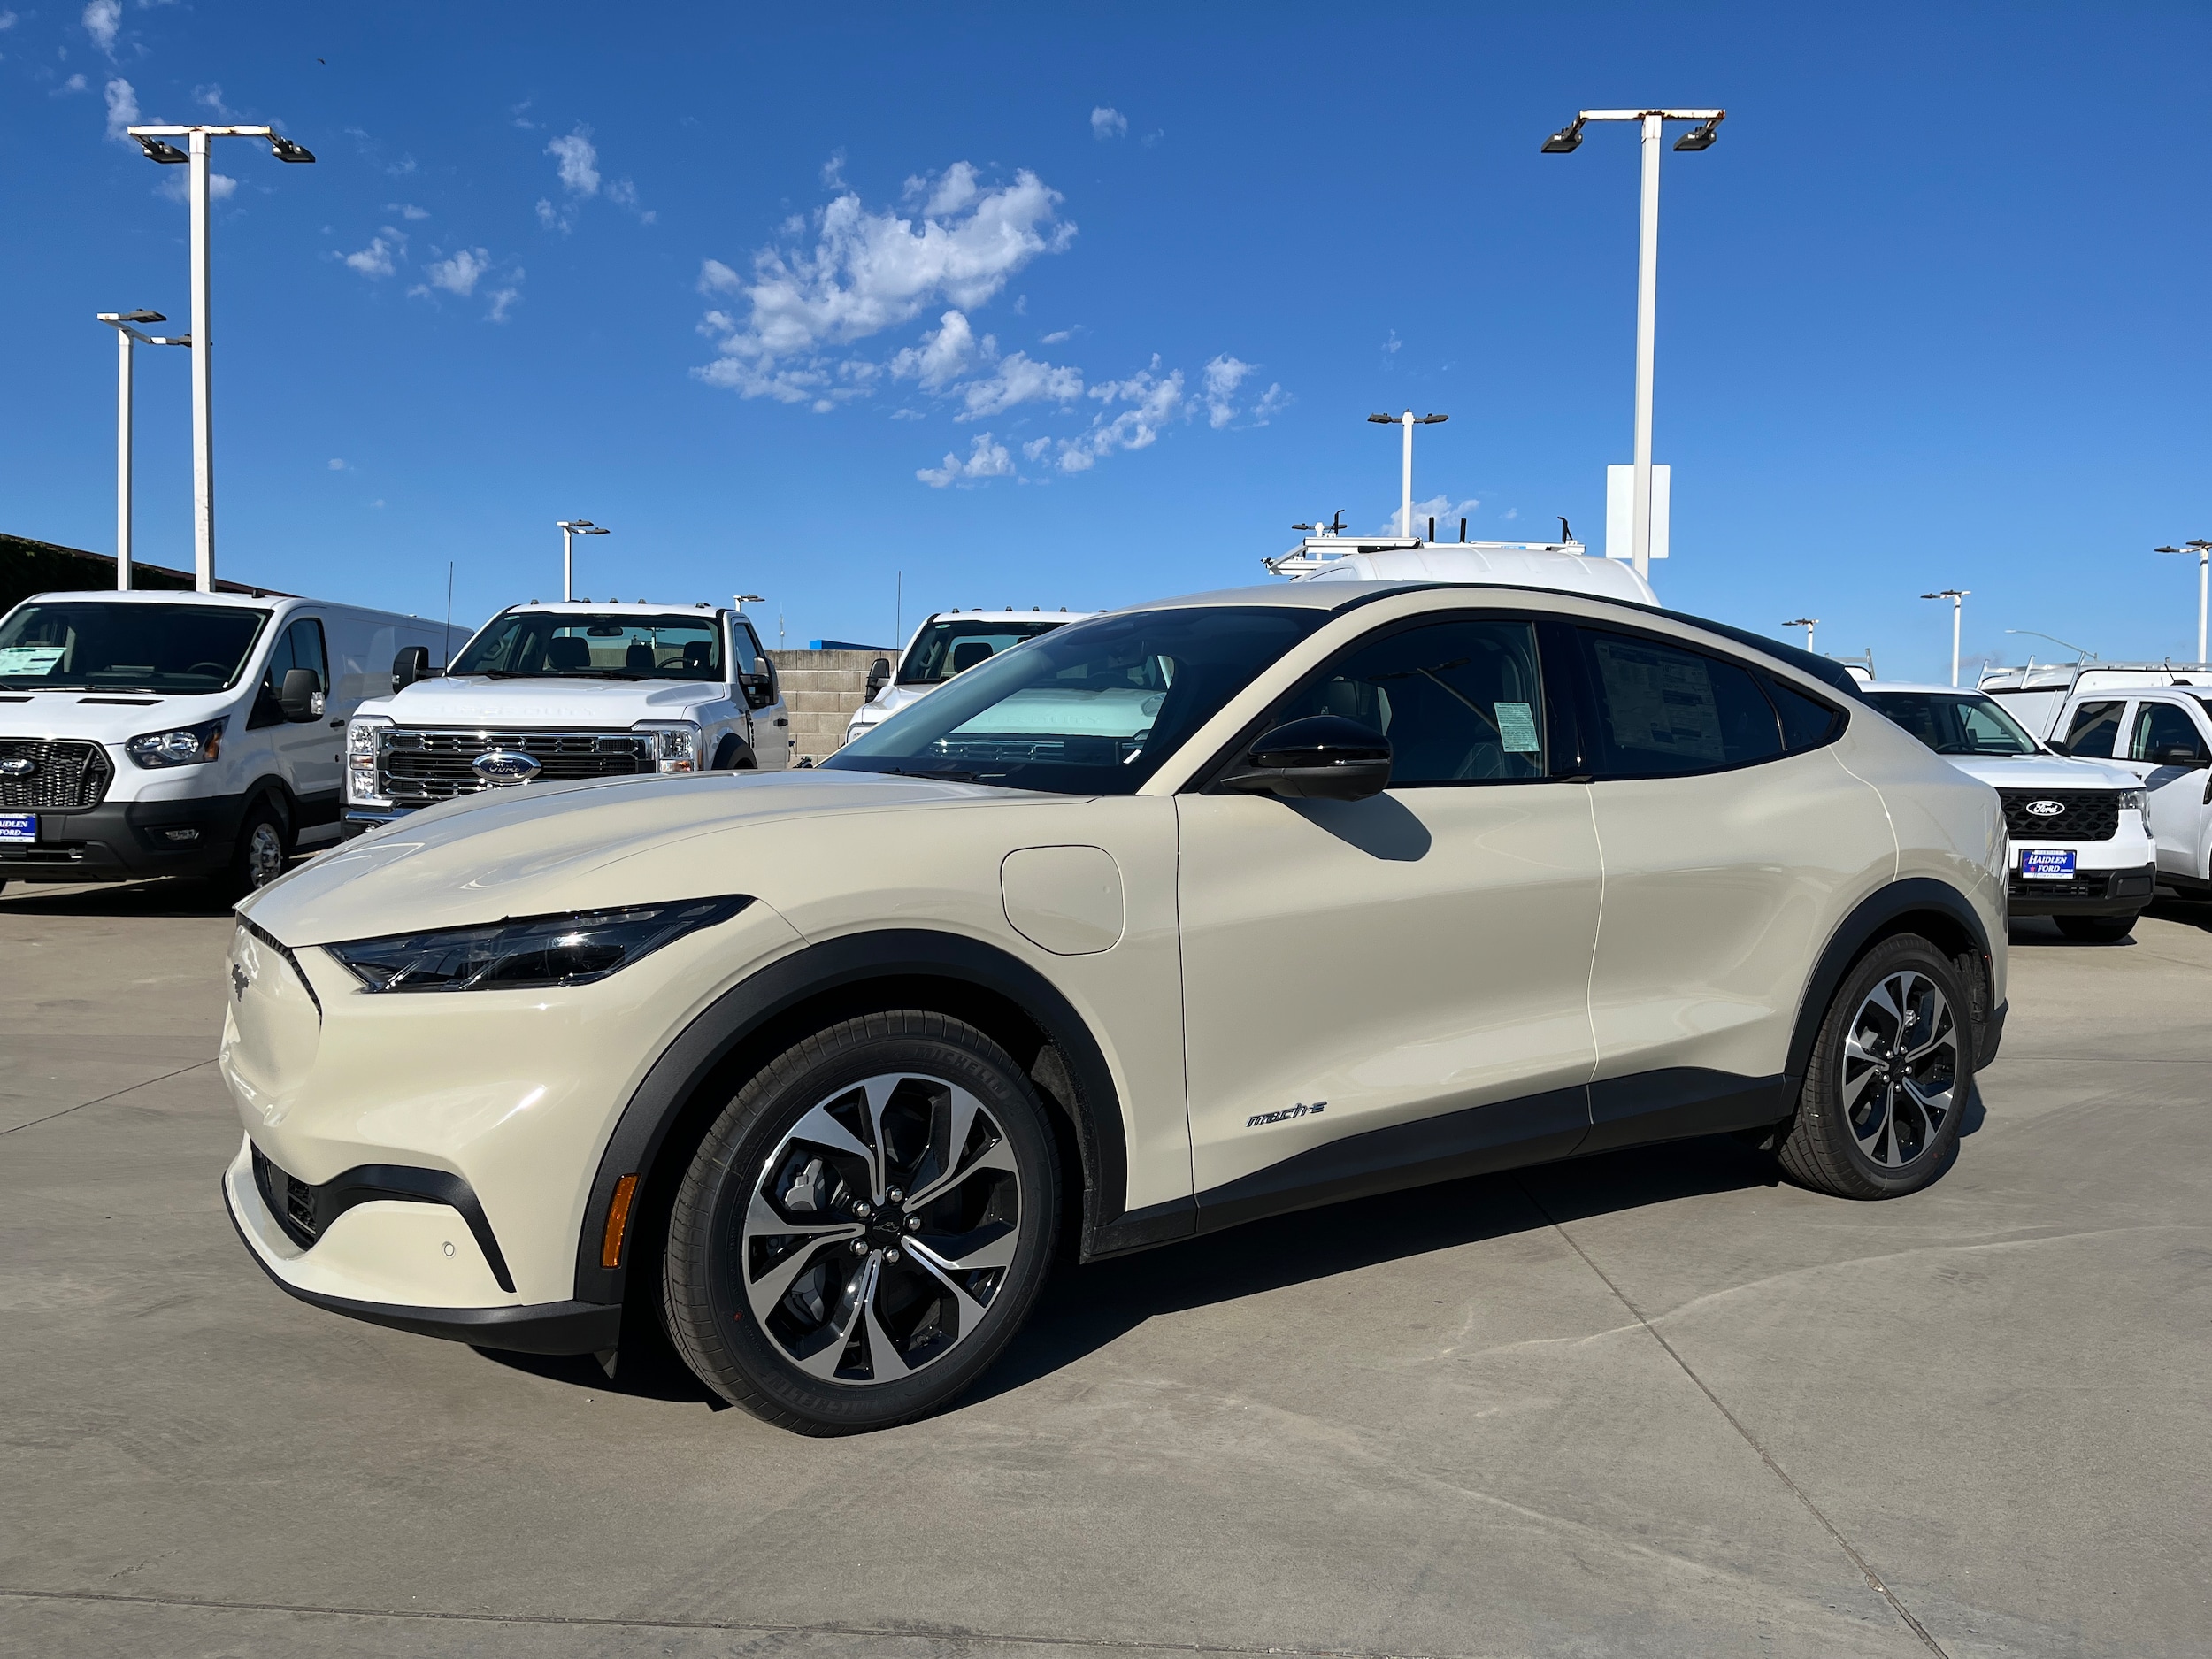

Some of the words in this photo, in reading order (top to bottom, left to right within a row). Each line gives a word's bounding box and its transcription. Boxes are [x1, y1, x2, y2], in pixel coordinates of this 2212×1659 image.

[2033, 803, 2058, 813] Ford
[2028, 855, 2068, 864] HAIDLEN
[916, 1047, 1009, 1095] MICHELIN
[767, 1376, 872, 1416] MICHELIN
